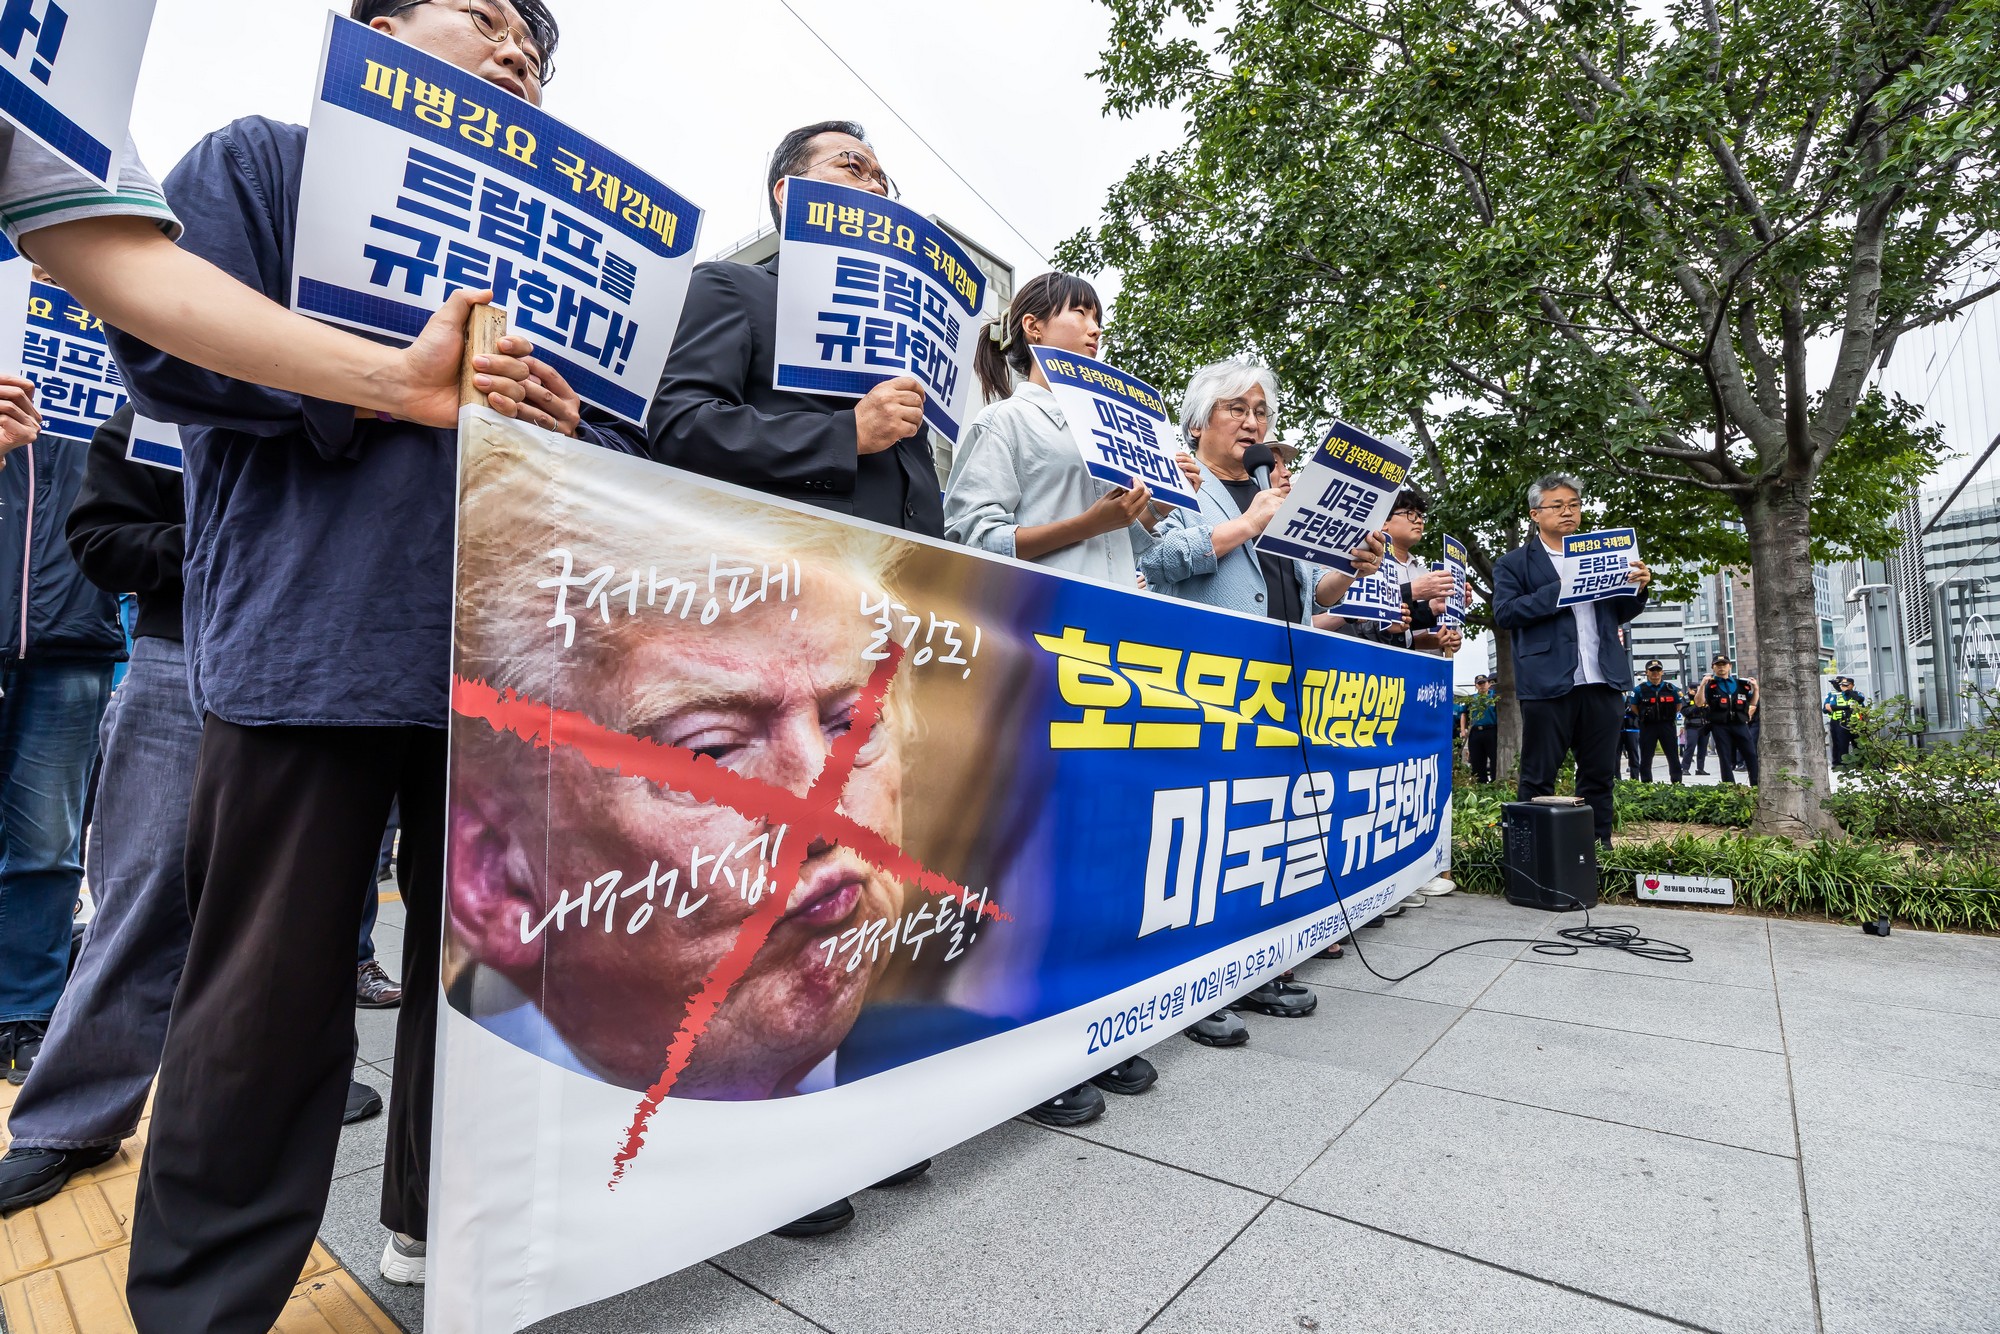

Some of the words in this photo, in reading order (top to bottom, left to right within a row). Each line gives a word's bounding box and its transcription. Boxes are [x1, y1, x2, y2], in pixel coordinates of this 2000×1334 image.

[361, 58, 538, 170] 파병강요
[552, 146, 679, 249] 국제깡패
[396, 146, 638, 306] 트럼프를
[806, 201, 917, 256] 파병강요
[922, 236, 978, 310] 국제깡패
[363, 214, 639, 377] 규탄한다!
[832, 256, 960, 354] 트럼프를
[815, 311, 959, 408] 규탄한다!
[1045, 358, 1078, 379] 이란
[1077, 364, 1127, 396] 침략전쟁
[1126, 383, 1165, 416] 파병강요
[1091, 428, 1184, 490] 규탄한다!
[1092, 397, 1160, 451] 미국을
[1325, 436, 1350, 459] 이란
[1345, 445, 1384, 474] 침략전쟁
[1379, 460, 1406, 484] 파병강요
[1284, 507, 1371, 554] 규탄한다!
[1316, 478, 1379, 523] 미국을
[1569, 539, 1602, 553] 파병강요
[1602, 535, 1632, 549] 국제깡패
[537, 548, 801, 648] 국제깡패!
[1572, 571, 1631, 595] 규탄한다!
[1578, 554, 1629, 575] 트럼프를
[859, 591, 981, 680] 날강도!
[1033, 625, 1300, 751] 호르무즈
[1300, 668, 1406, 748] 파병압박
[520, 823, 790, 945] 내정간섭!
[1137, 770, 1335, 939] 미국을
[1340, 753, 1439, 877] 규탄한다!
[819, 885, 988, 973] 경제수탈!
[1086, 993, 1156, 1055] 2026년
[1159, 982, 1188, 1020] 9월
[1190, 960, 1241, 1006] 10일(목)
[1243, 947, 1266, 982] 오후
[1267, 938, 1286, 970] 2시
